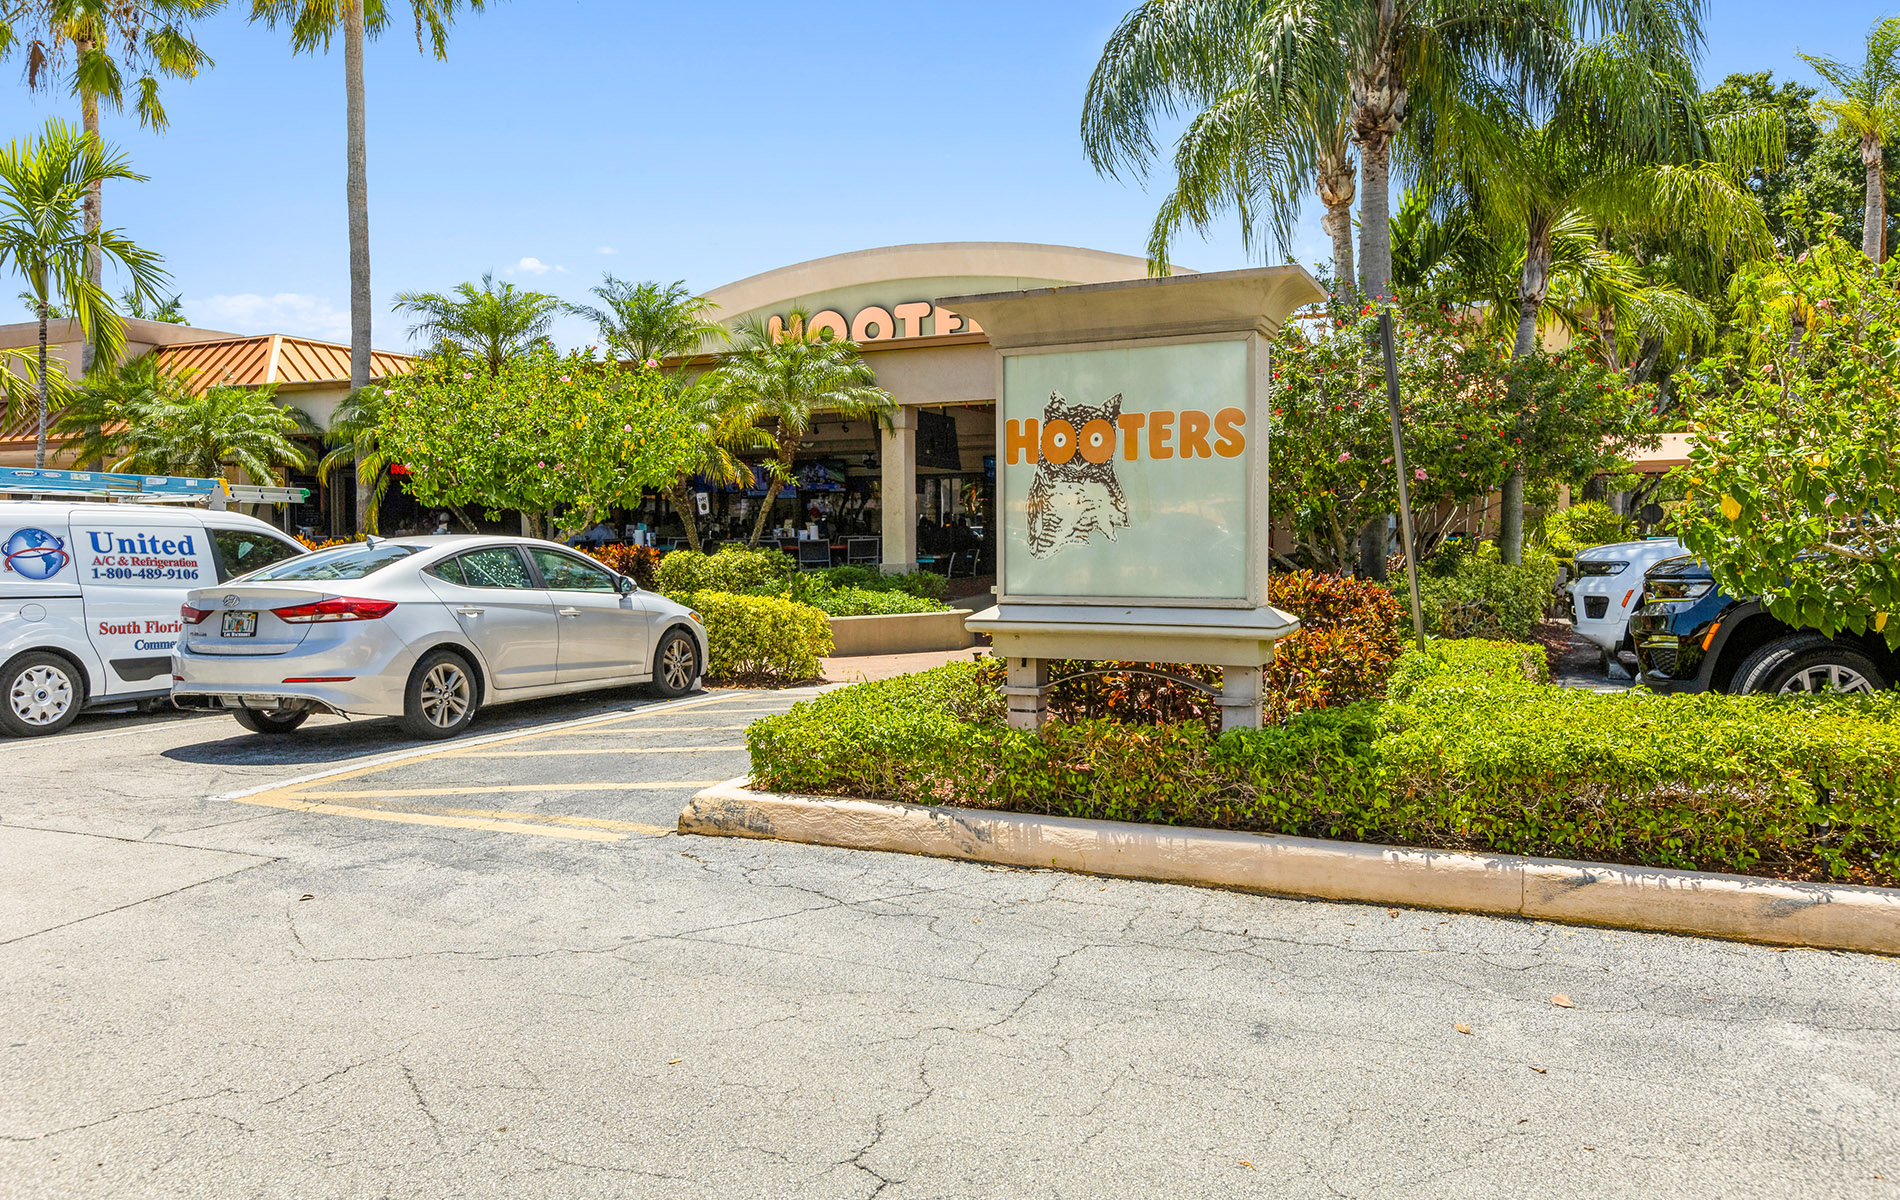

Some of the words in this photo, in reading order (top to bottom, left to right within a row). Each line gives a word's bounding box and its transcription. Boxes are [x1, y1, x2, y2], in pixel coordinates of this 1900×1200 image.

[768, 302, 984, 345] HOOTE
[1005, 408, 1246, 465] HOOTERS
[86, 531, 196, 556] United
[91, 556, 115, 566] A/C
[117, 556, 129, 566] &
[130, 556, 198, 569] Refrigeration
[91, 567, 199, 579] 1-800-489-9106
[99, 621, 141, 635] South
